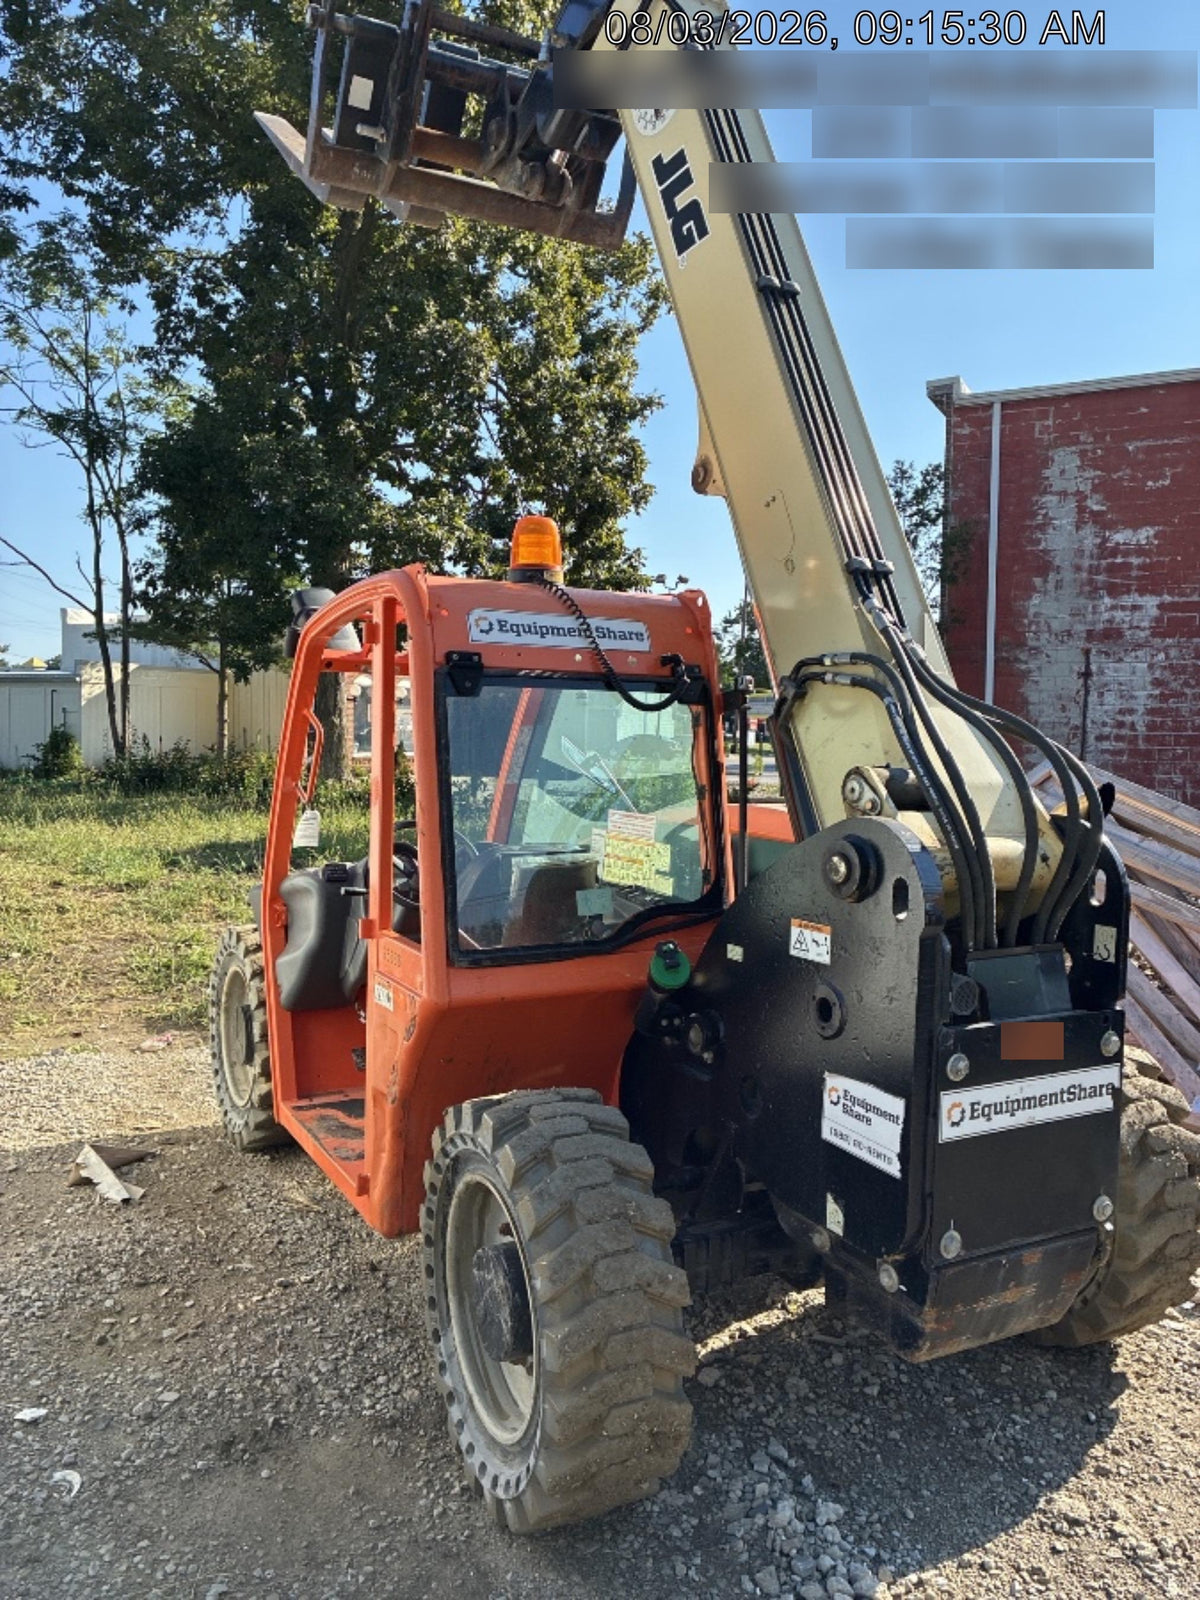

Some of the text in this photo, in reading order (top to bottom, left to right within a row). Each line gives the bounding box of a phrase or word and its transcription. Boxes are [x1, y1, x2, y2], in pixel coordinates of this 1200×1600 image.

[650, 145, 711, 258] JLG
[497, 619, 645, 642] EquipmenShare
[842, 1102, 873, 1126] Share
[843, 1089, 901, 1126] Equipment
[968, 1082, 1115, 1122] EquipmentShare
